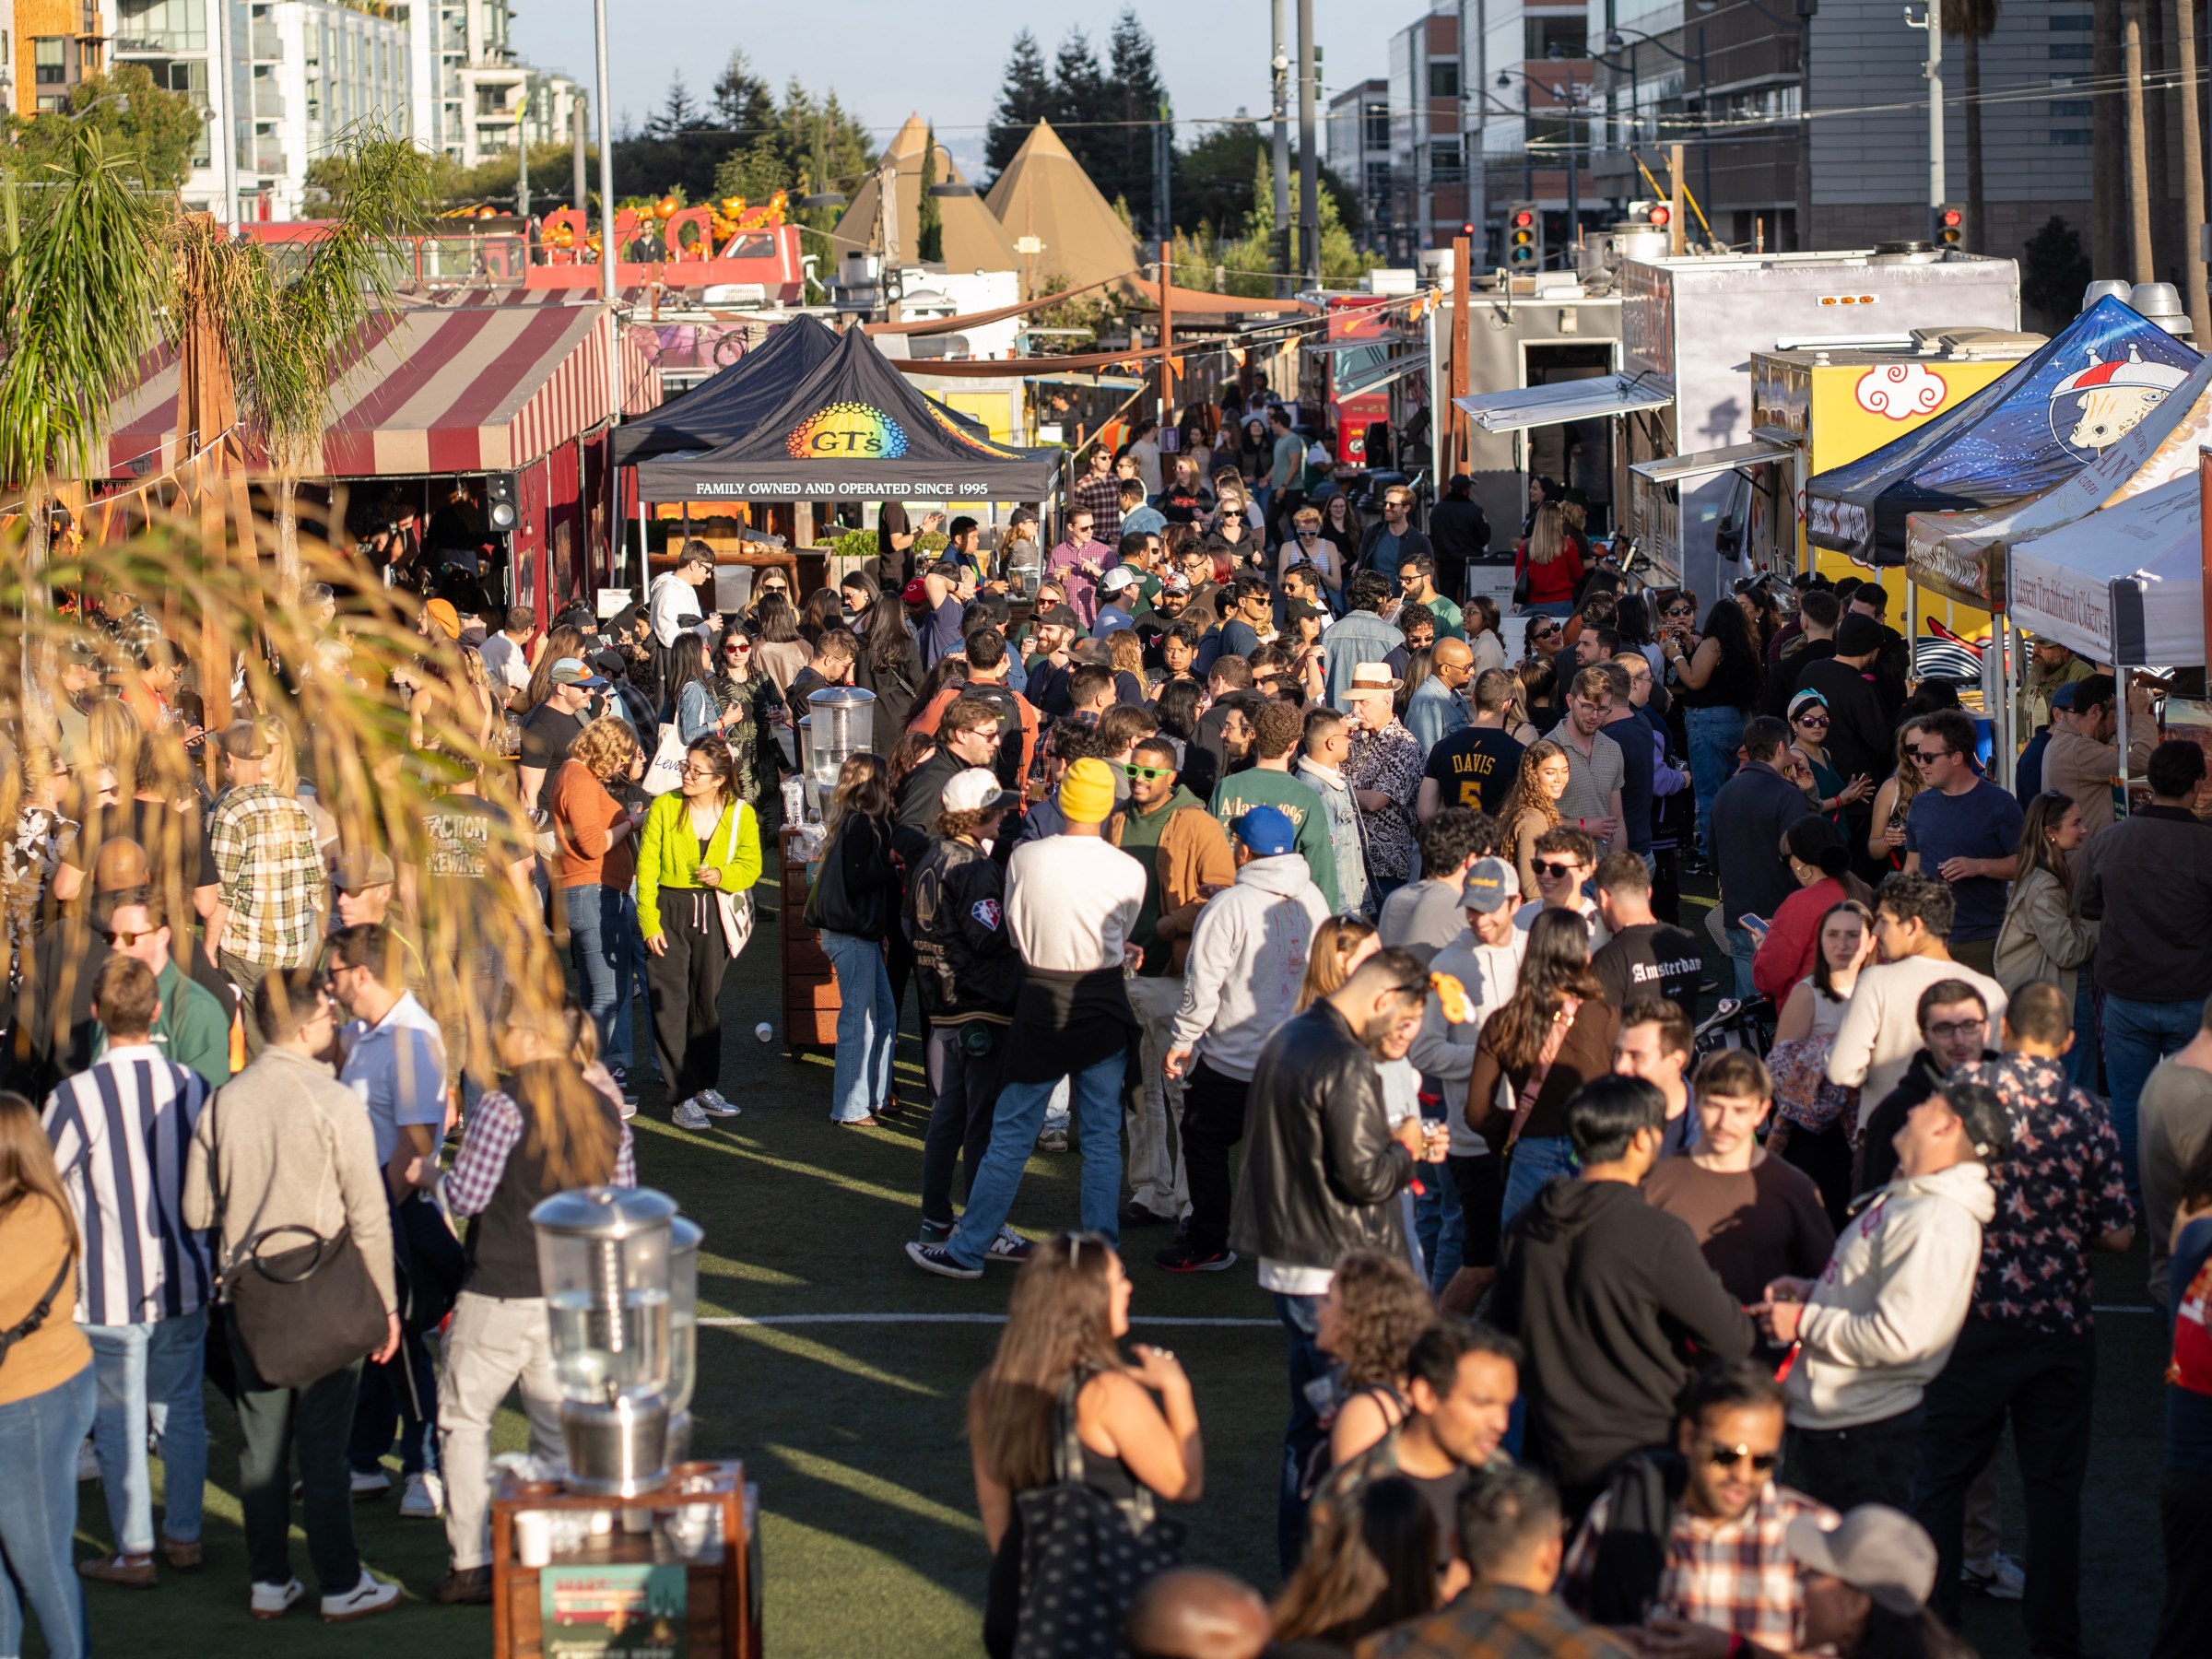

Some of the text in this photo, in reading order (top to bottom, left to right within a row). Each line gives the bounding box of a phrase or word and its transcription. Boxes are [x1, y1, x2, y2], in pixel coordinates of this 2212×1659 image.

[2130, 425, 2147, 456] GROWN
[696, 483, 988, 495] FAMILY OWNED AND OPERATED SINCE 1995
[2015, 568, 2037, 608] Lassen
[2038, 576, 2077, 624] Traditional
[1453, 753, 1496, 775] DAVIS
[1219, 796, 1267, 817] Atla
[1459, 781, 1483, 811] 5
[423, 815, 488, 841] FACTION
